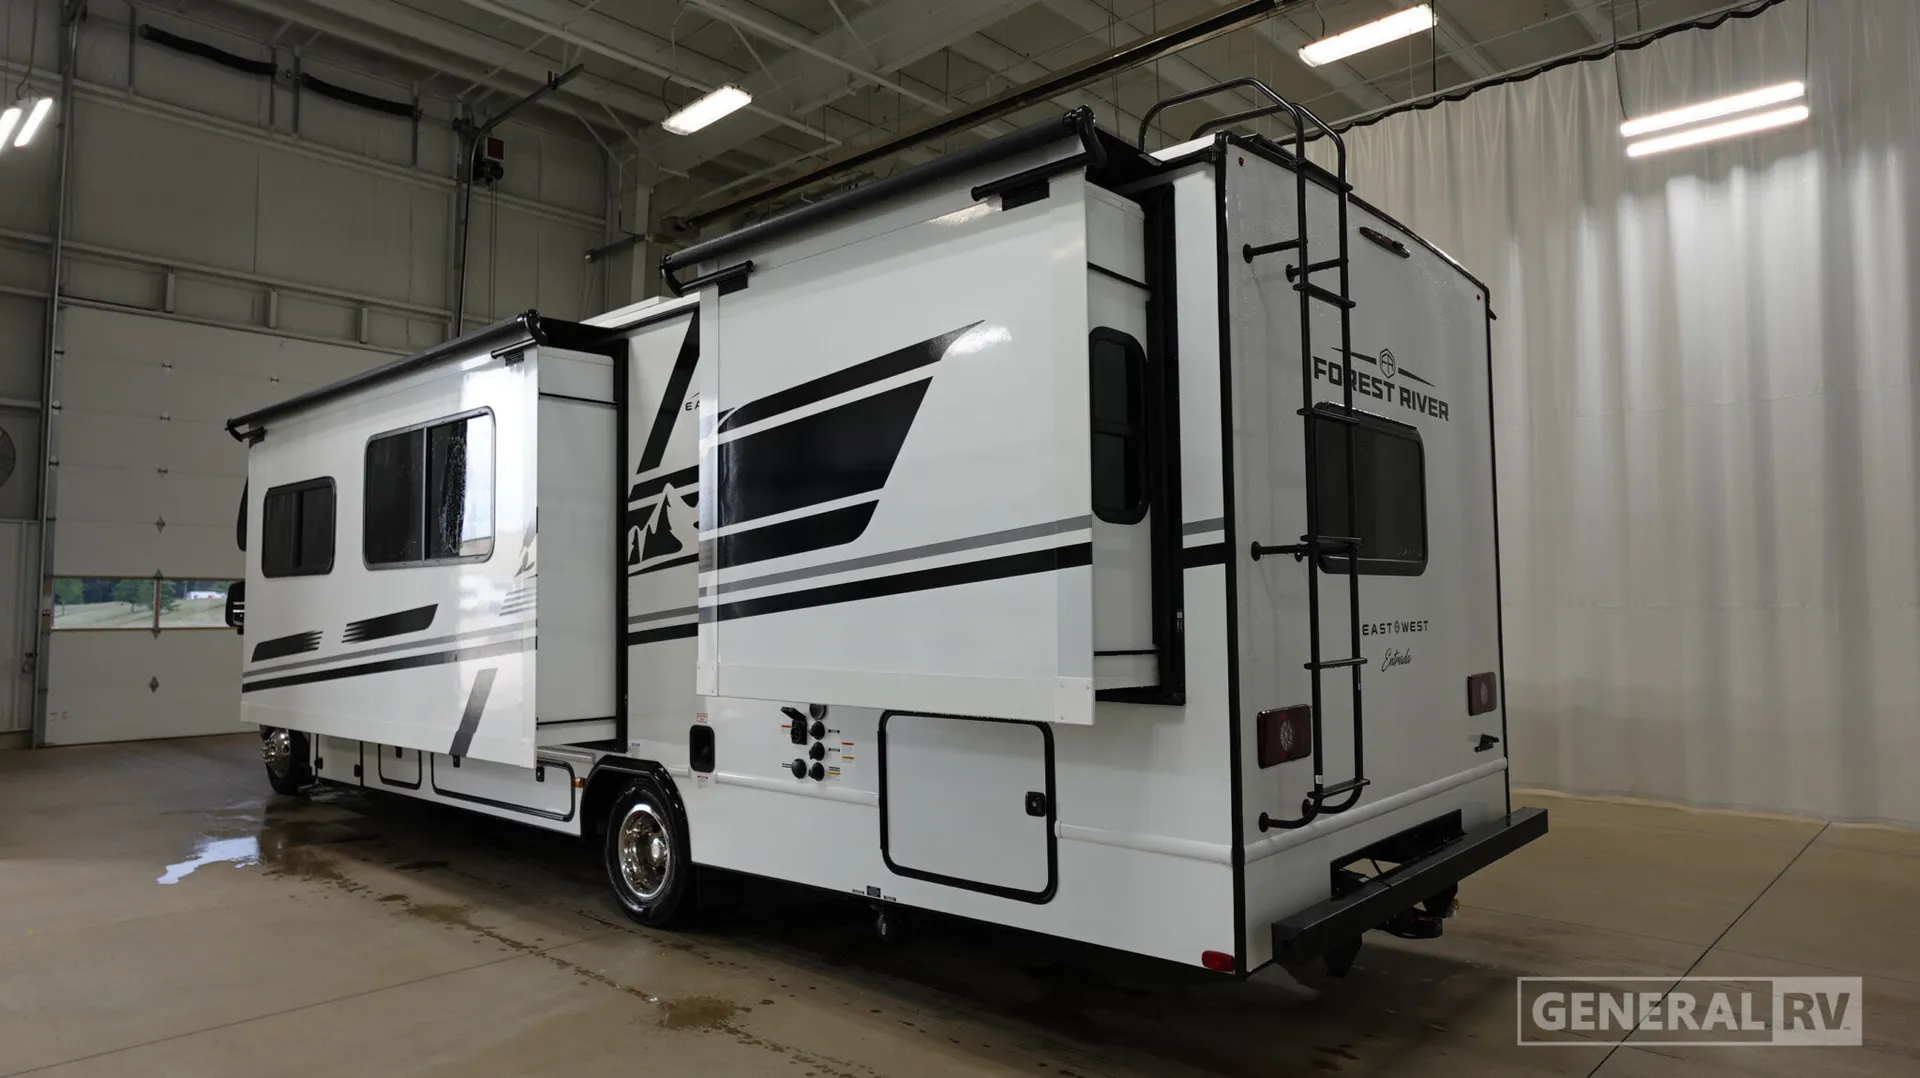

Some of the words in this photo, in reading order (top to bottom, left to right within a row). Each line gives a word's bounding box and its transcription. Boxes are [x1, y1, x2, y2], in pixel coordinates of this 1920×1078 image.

[1398, 386, 1449, 422] RIVER
[1362, 622, 1393, 636] EAST
[1401, 620, 1429, 633] WEST
